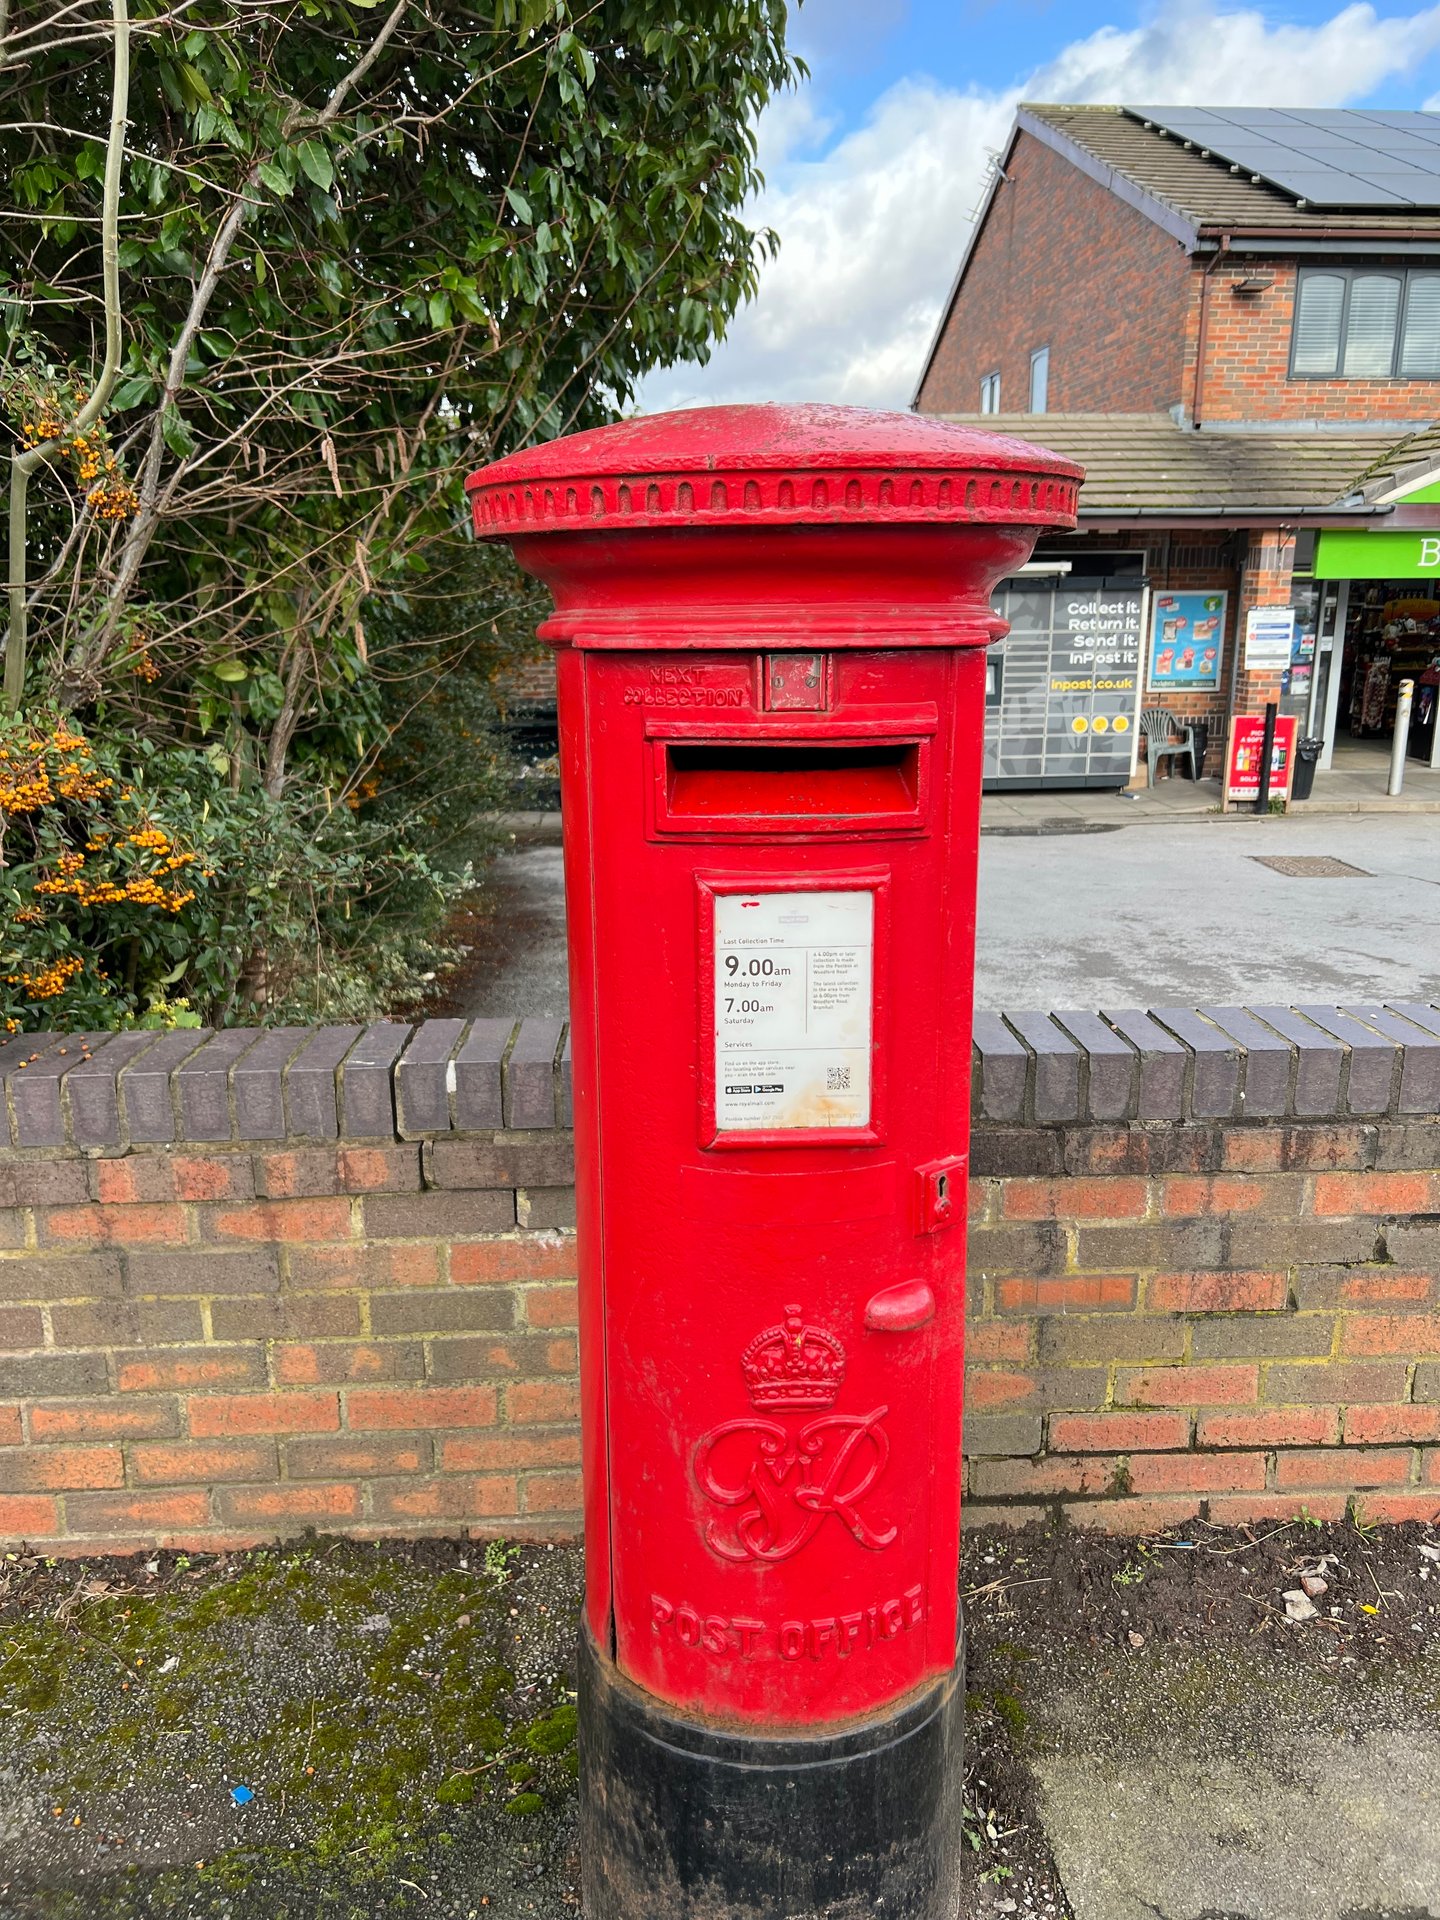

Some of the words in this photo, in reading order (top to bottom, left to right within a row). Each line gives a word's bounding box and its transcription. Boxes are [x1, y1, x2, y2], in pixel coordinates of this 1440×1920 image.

[1068, 602, 1126, 614] Collect
[1126, 601, 1140, 614] it.
[1068, 618, 1122, 630] Return
[1126, 617, 1139, 629] it.
[1073, 634, 1117, 647] Send
[1123, 634, 1137, 646] it.
[1069, 653, 1120, 664] InPost
[1123, 652, 1137, 663] it.
[650, 667, 705, 684] NEXT
[1051, 678, 1133, 692] inpost.co.uk
[624, 686, 743, 706] COLLECTION
[725, 955, 790, 976] 9.00am
[725, 998, 774, 1013] 7.00am
[650, 1592, 766, 1661] POST
[776, 1583, 923, 1661] OFFICE
